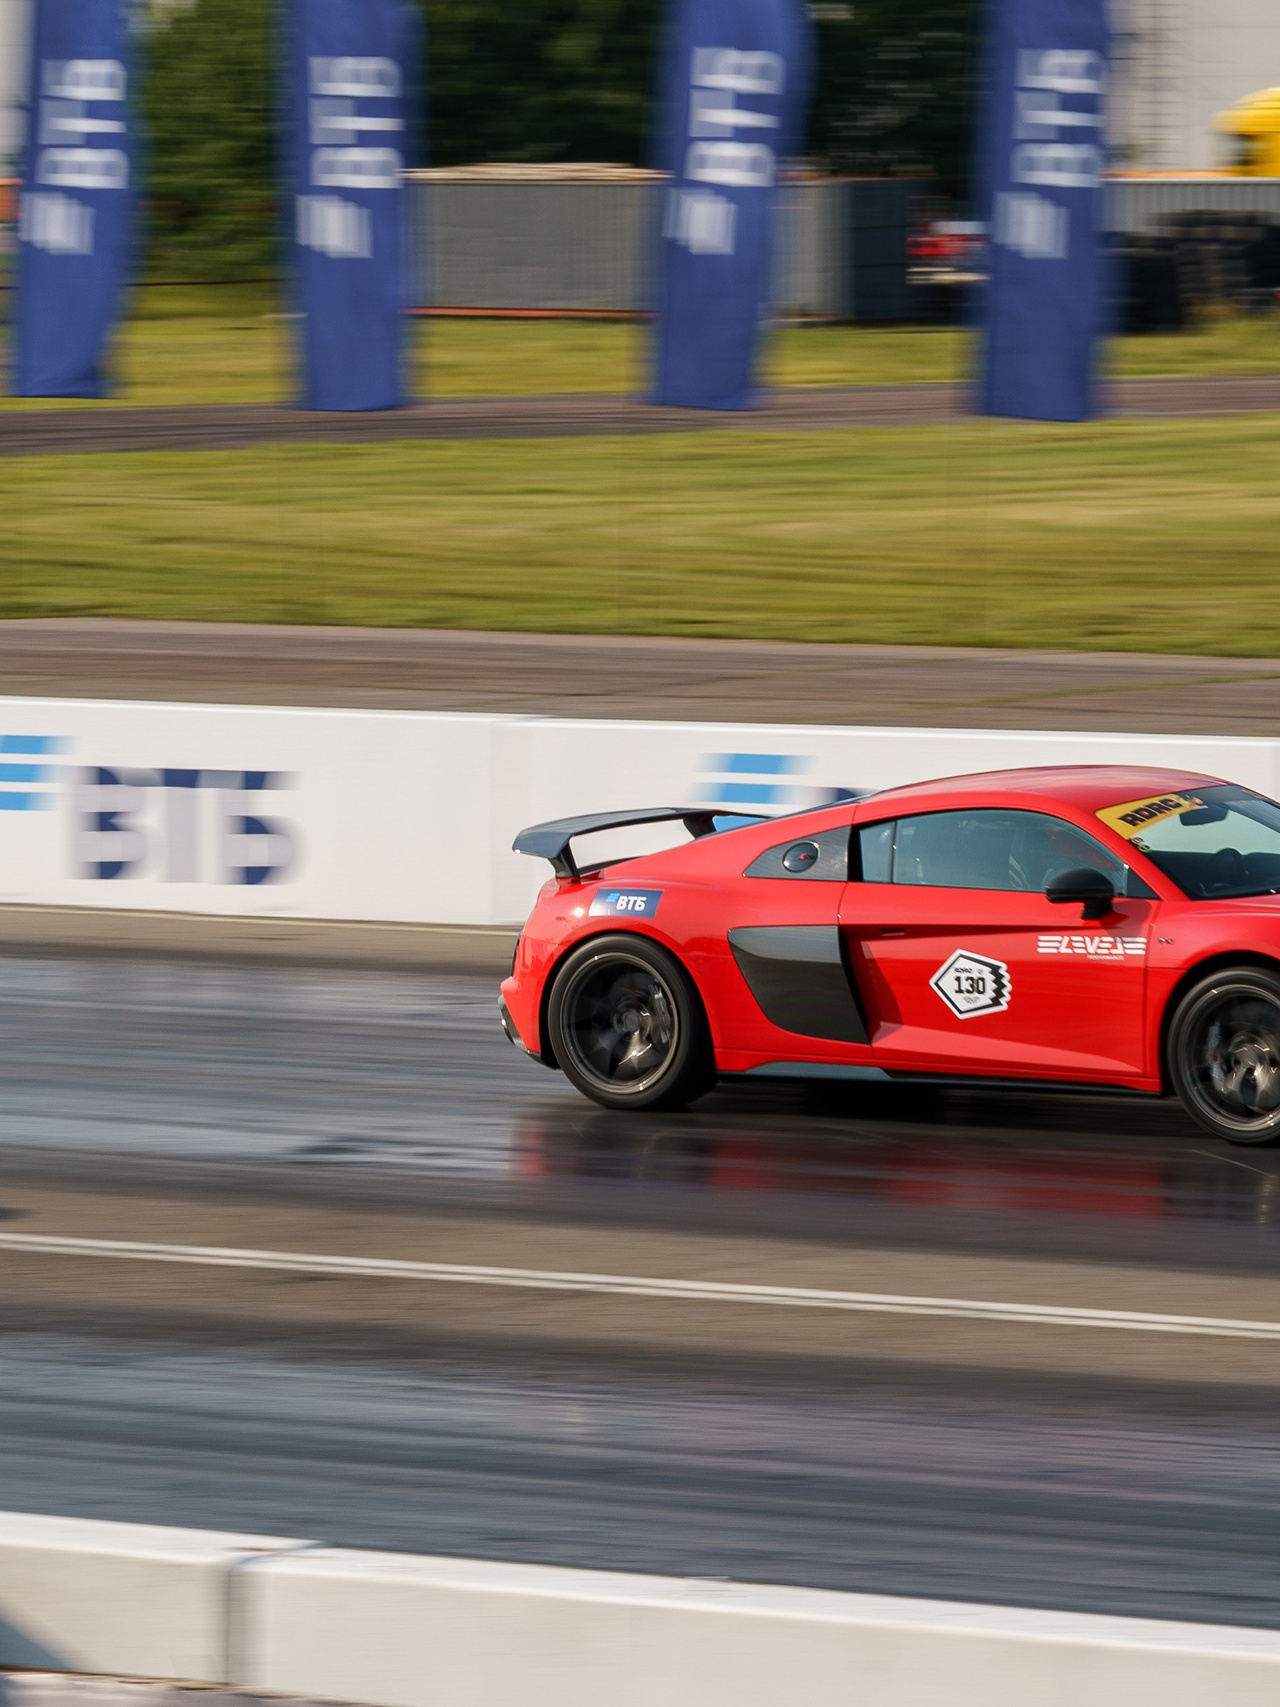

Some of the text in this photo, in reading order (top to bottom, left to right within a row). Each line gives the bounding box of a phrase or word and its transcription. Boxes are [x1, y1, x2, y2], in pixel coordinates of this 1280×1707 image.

[69, 766, 302, 885] ВТБ
[616, 895, 647, 911] ВТБ
[954, 976, 986, 994] 130
